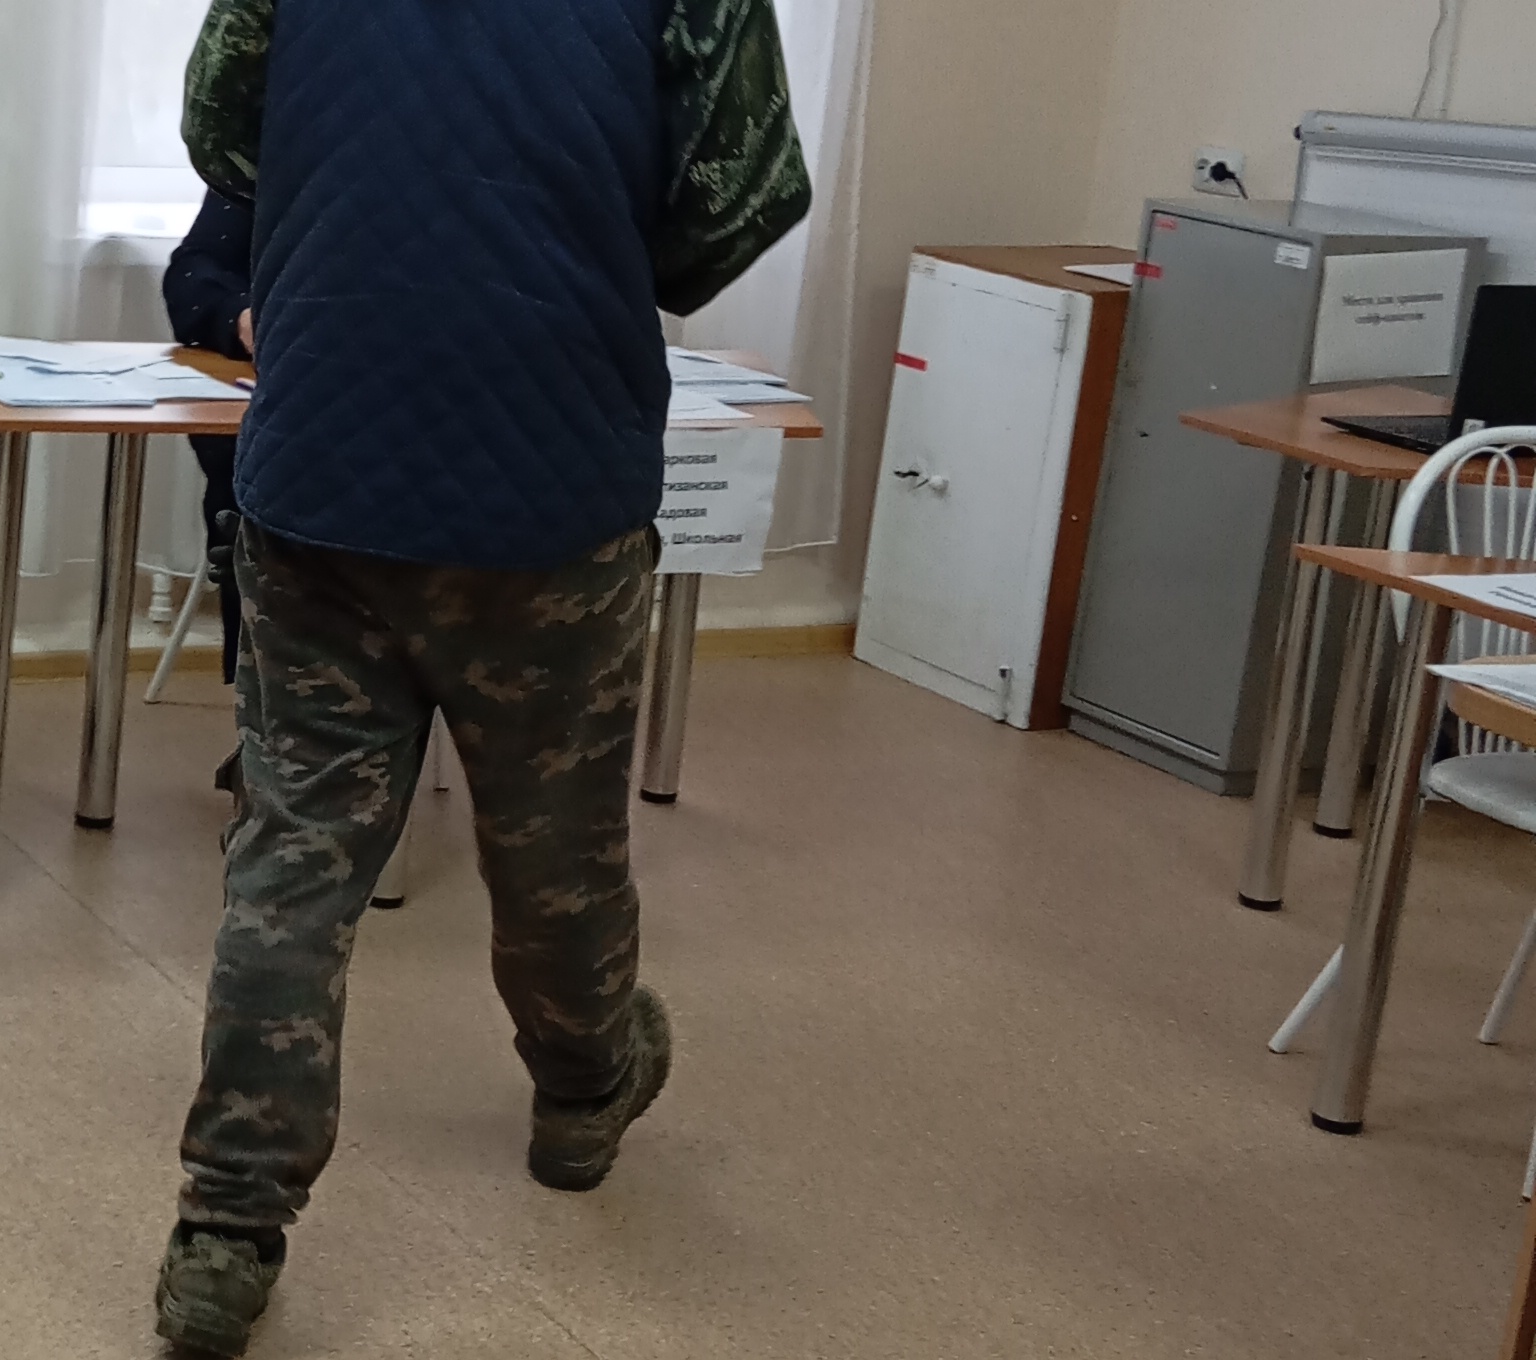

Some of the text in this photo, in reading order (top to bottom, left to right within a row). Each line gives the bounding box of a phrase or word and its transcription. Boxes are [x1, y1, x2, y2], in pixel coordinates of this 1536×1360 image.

[663, 454, 717, 467] арковая
[662, 481, 728, 491] тизанская
[658, 508, 707, 521] адовая
[671, 532, 743, 545] Школьная
